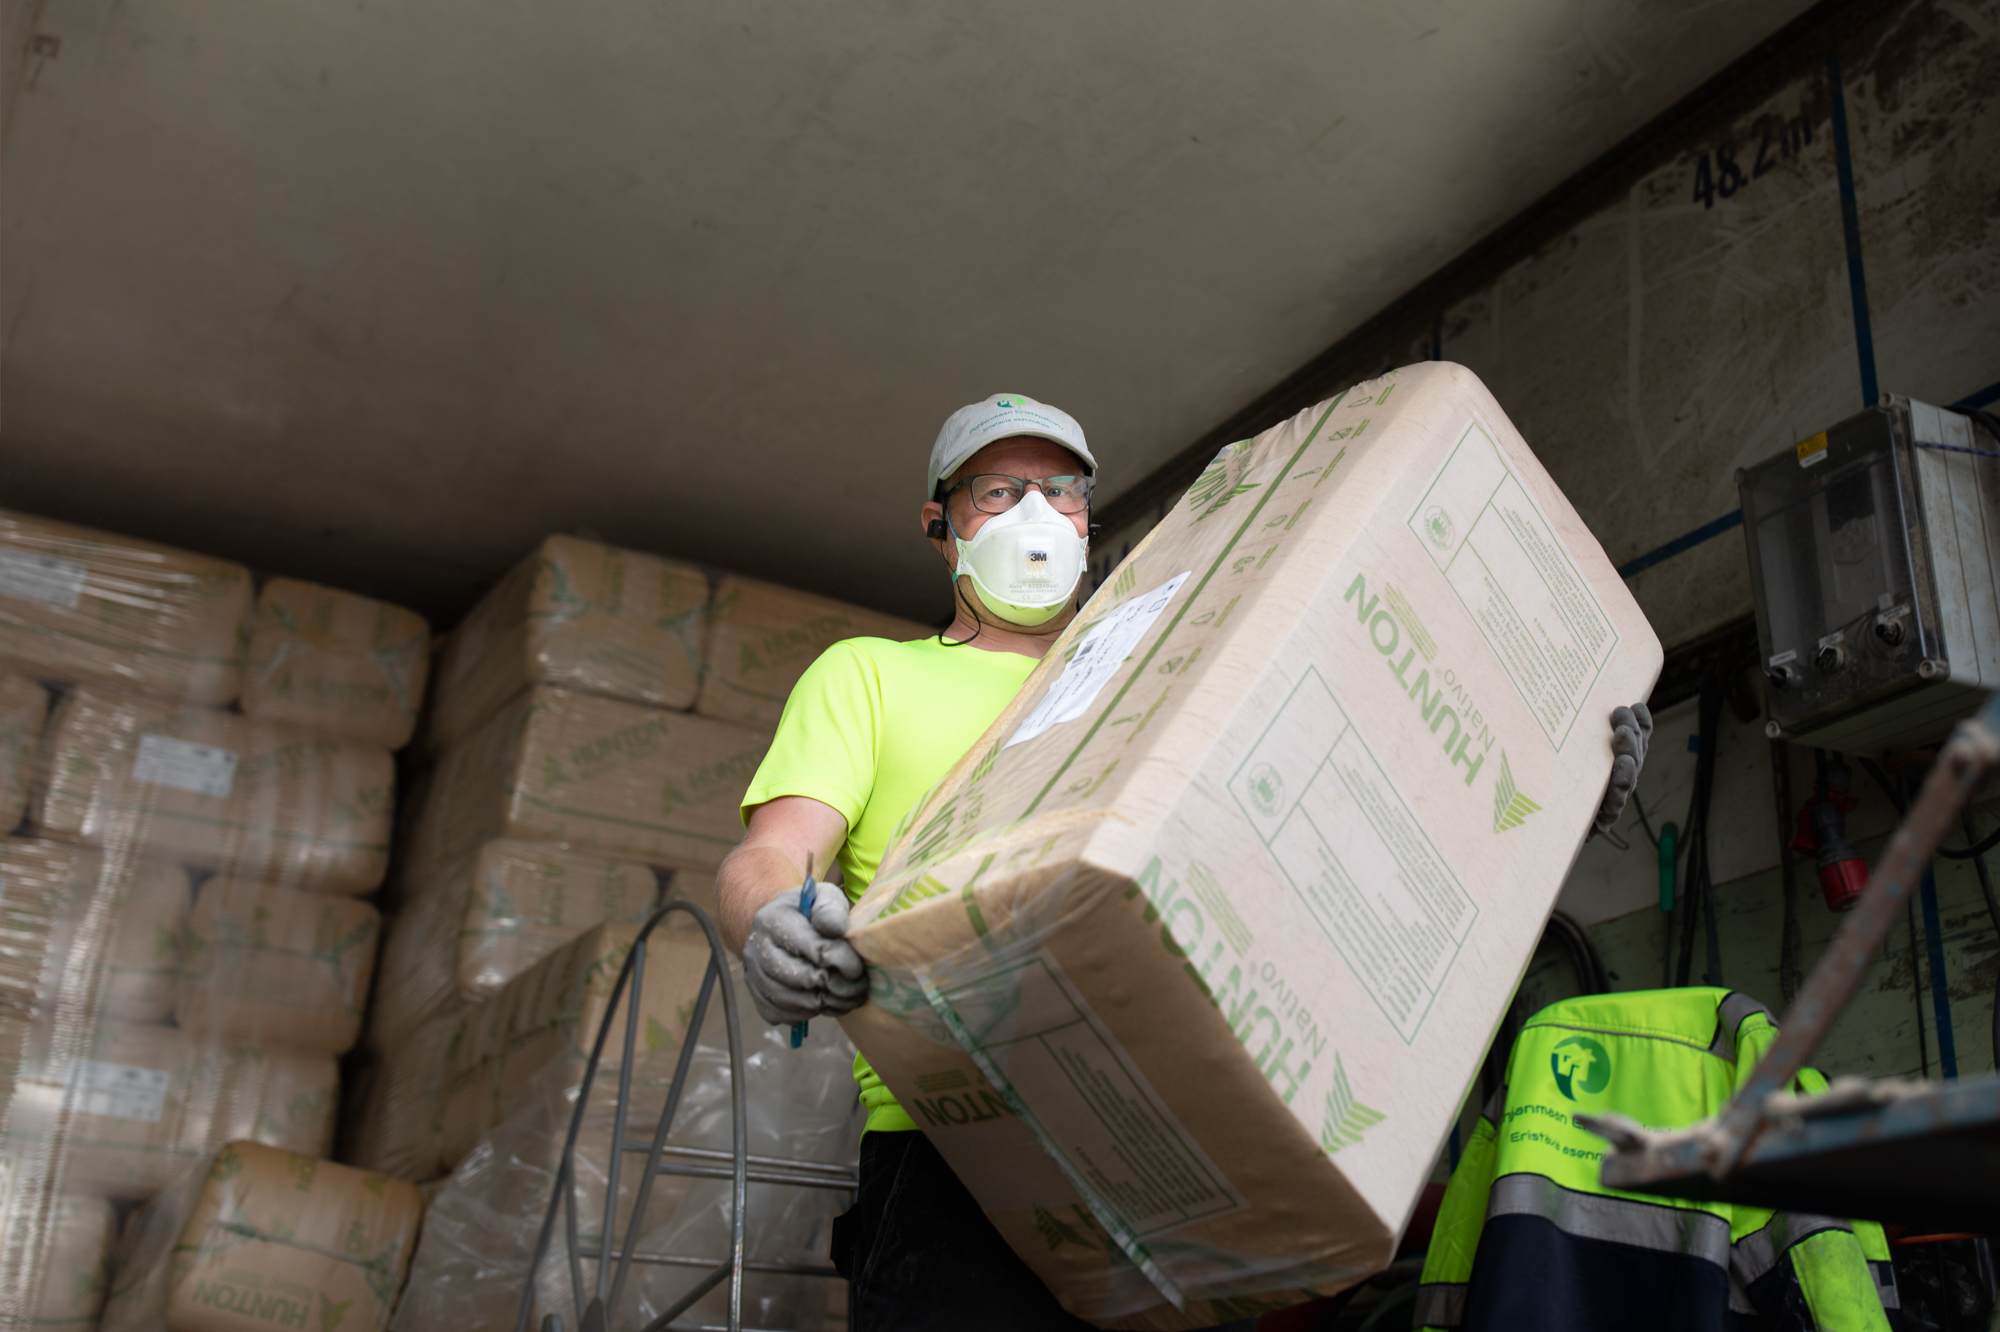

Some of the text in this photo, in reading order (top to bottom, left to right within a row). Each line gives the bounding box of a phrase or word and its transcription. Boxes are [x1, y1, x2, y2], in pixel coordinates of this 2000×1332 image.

[1030, 553, 1047, 562] 3M
[1343, 573, 1485, 787] HUNTON
[1559, 670, 1575, 696] HUNTON
[1125, 855, 1311, 1103] HUNTON
[192, 1278, 310, 1329] HUNTON
